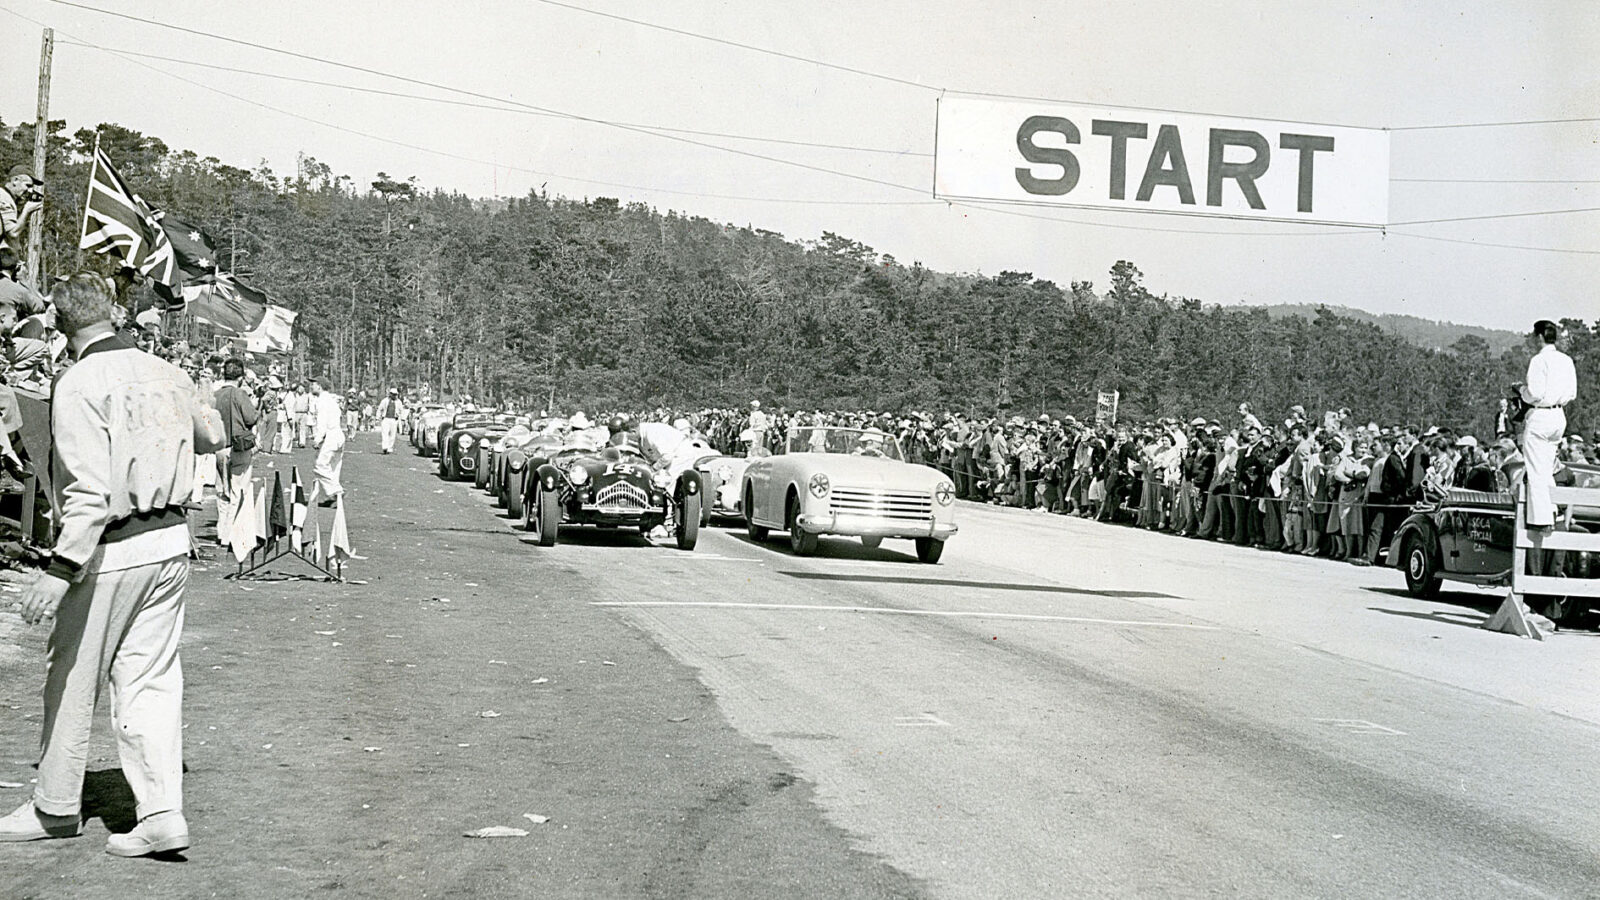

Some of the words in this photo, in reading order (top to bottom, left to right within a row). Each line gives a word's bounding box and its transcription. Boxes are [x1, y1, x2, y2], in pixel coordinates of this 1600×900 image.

[1015, 115, 1335, 213] START
[1472, 517, 1491, 529] SCCA
[1473, 542, 1486, 552] CAR
